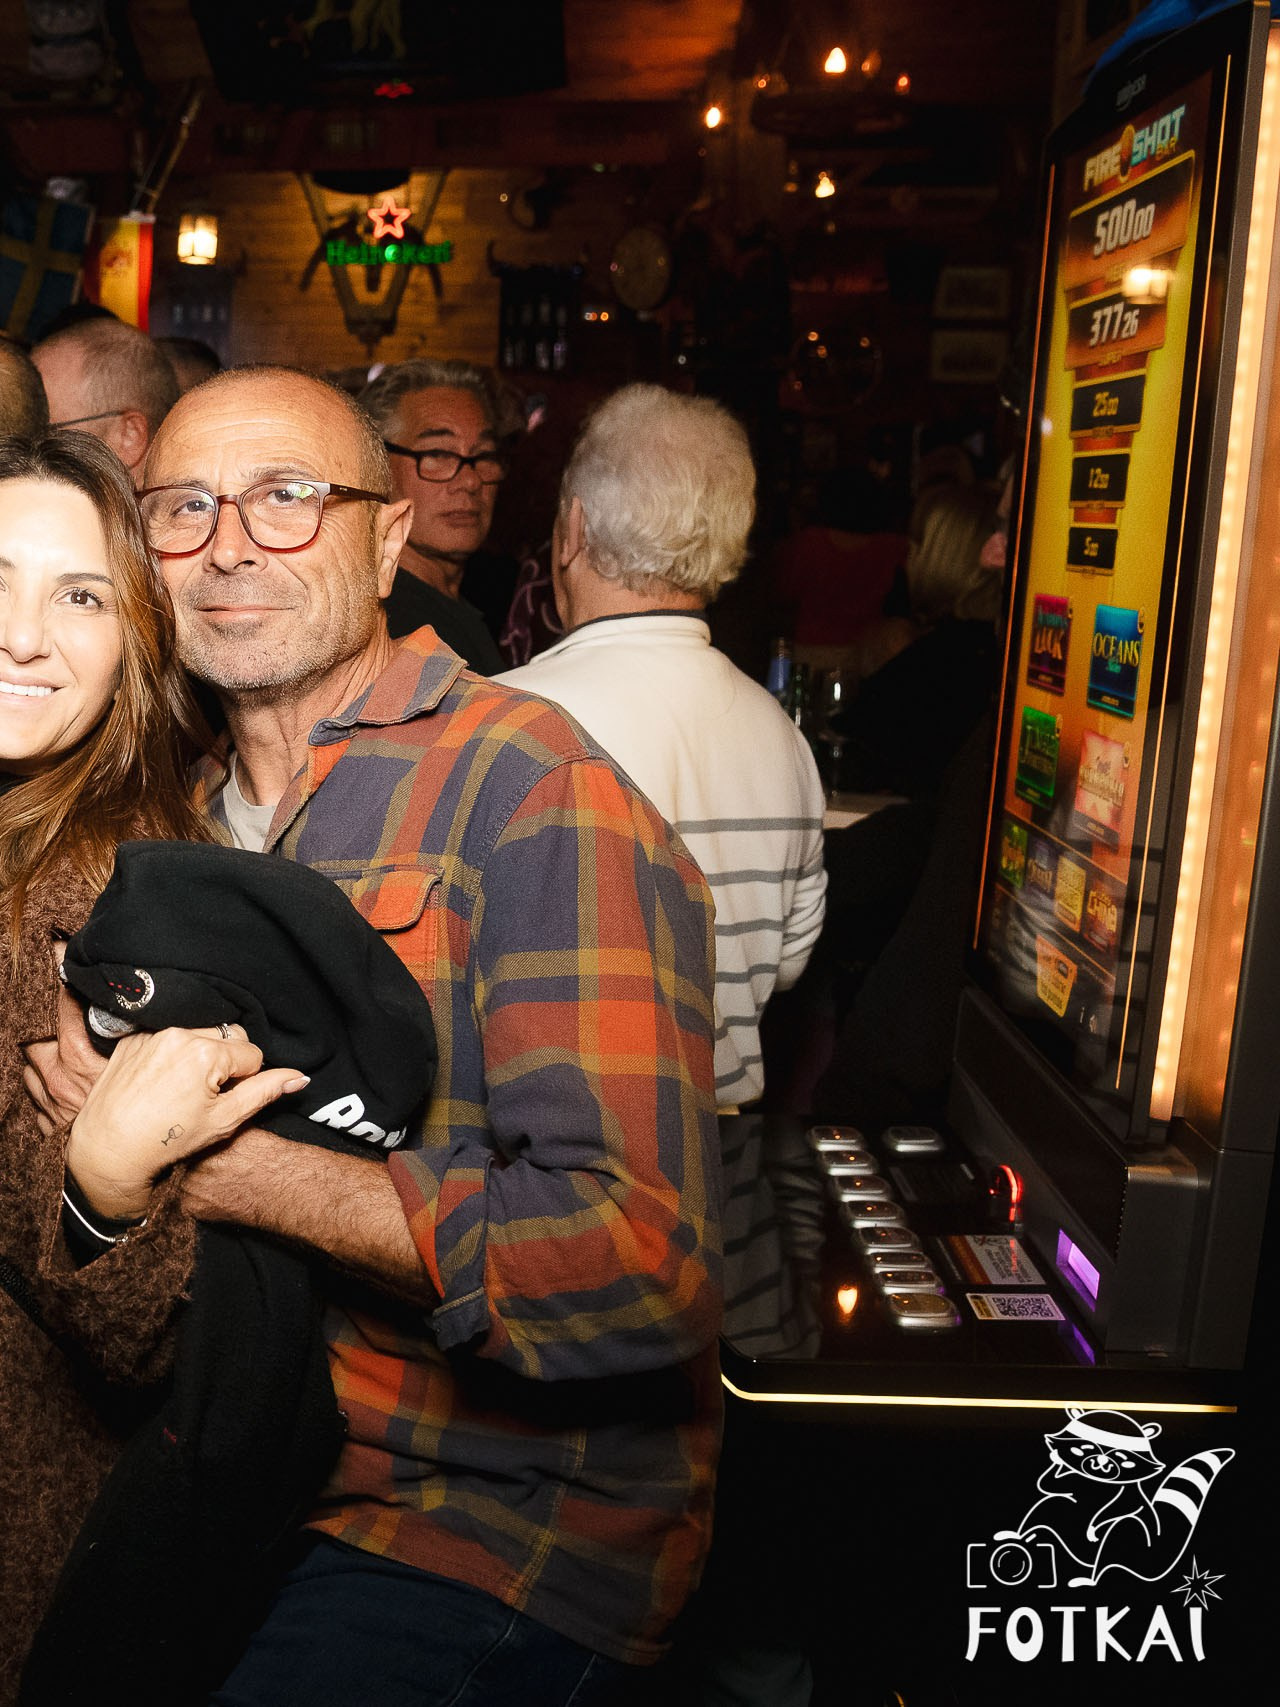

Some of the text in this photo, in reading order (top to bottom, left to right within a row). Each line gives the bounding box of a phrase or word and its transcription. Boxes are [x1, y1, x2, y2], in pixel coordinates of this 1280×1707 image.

[1083, 103, 1186, 192] FIRE SHOT
[1092, 632, 1141, 668] OCEANS
